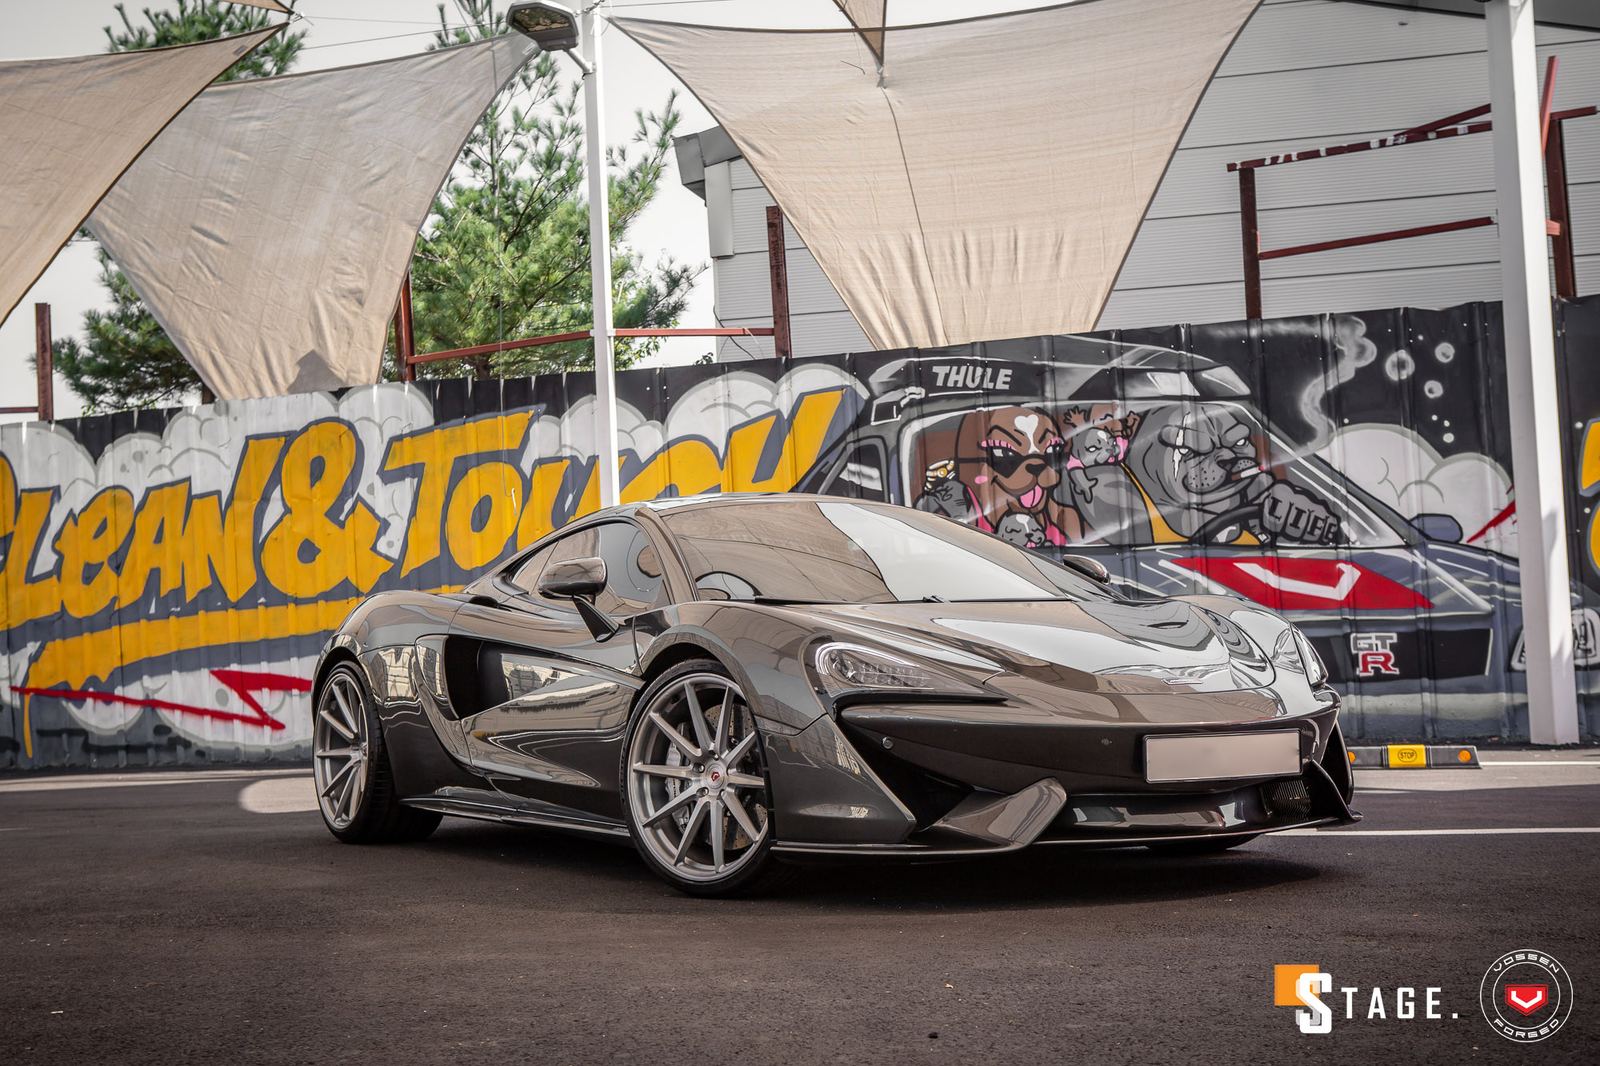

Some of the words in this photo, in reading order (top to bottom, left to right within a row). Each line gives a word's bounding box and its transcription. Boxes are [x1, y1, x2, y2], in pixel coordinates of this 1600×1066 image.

[932, 365, 1013, 390] THULE
[261, 419, 397, 597] &
[1268, 496, 1337, 541] LIFE
[1350, 632, 1398, 654] GT
[1356, 650, 1400, 676] R
[1399, 751, 1415, 760] STOP
